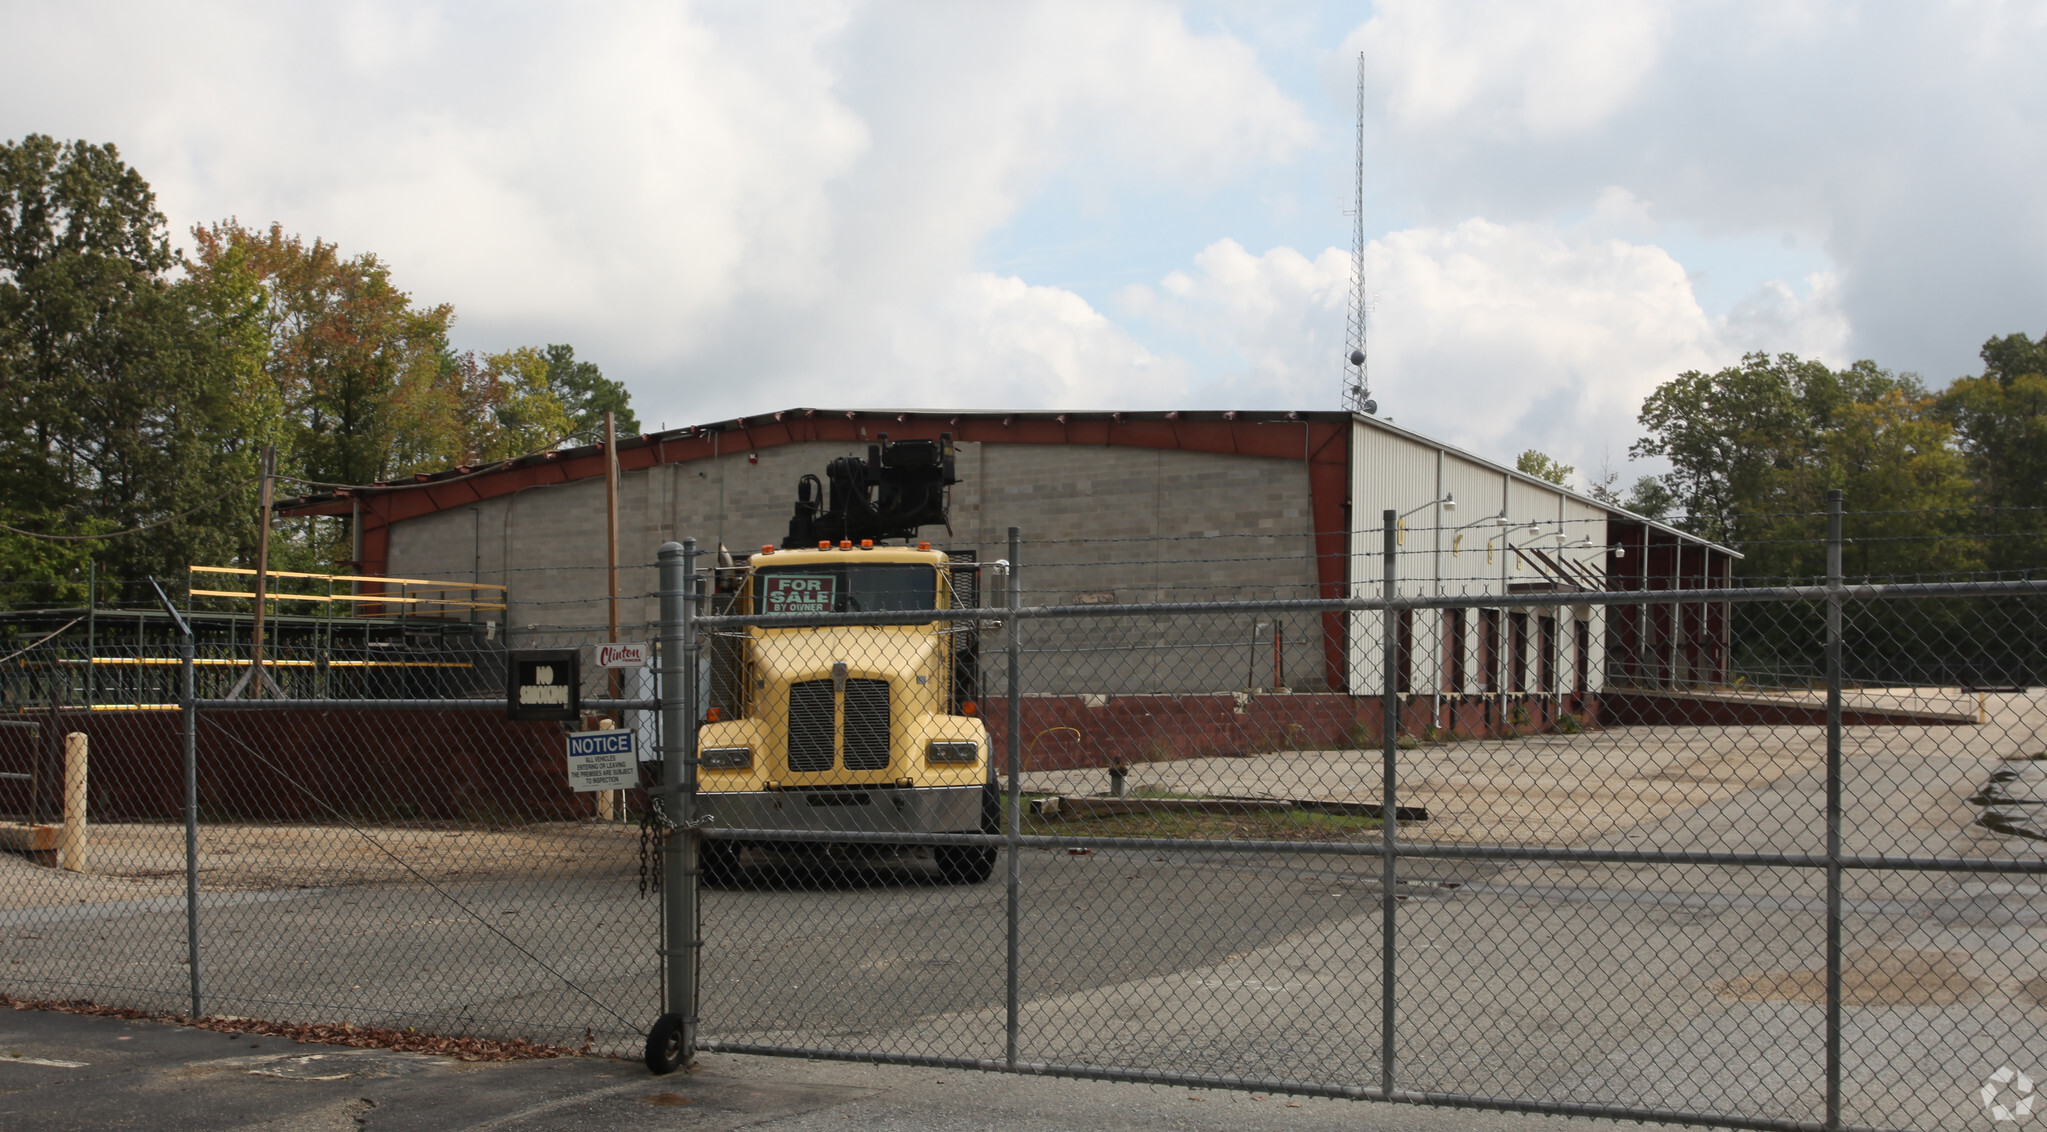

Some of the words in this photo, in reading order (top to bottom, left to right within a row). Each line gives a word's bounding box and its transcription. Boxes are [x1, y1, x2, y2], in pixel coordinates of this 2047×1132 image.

[779, 579, 821, 591] FOR
[770, 591, 829, 603] SALE
[774, 603, 787, 611] BY
[790, 603, 823, 611] OWNER
[601, 645, 640, 666] Clinton
[536, 665, 554, 685] NO
[572, 735, 628, 754] NOTICE
